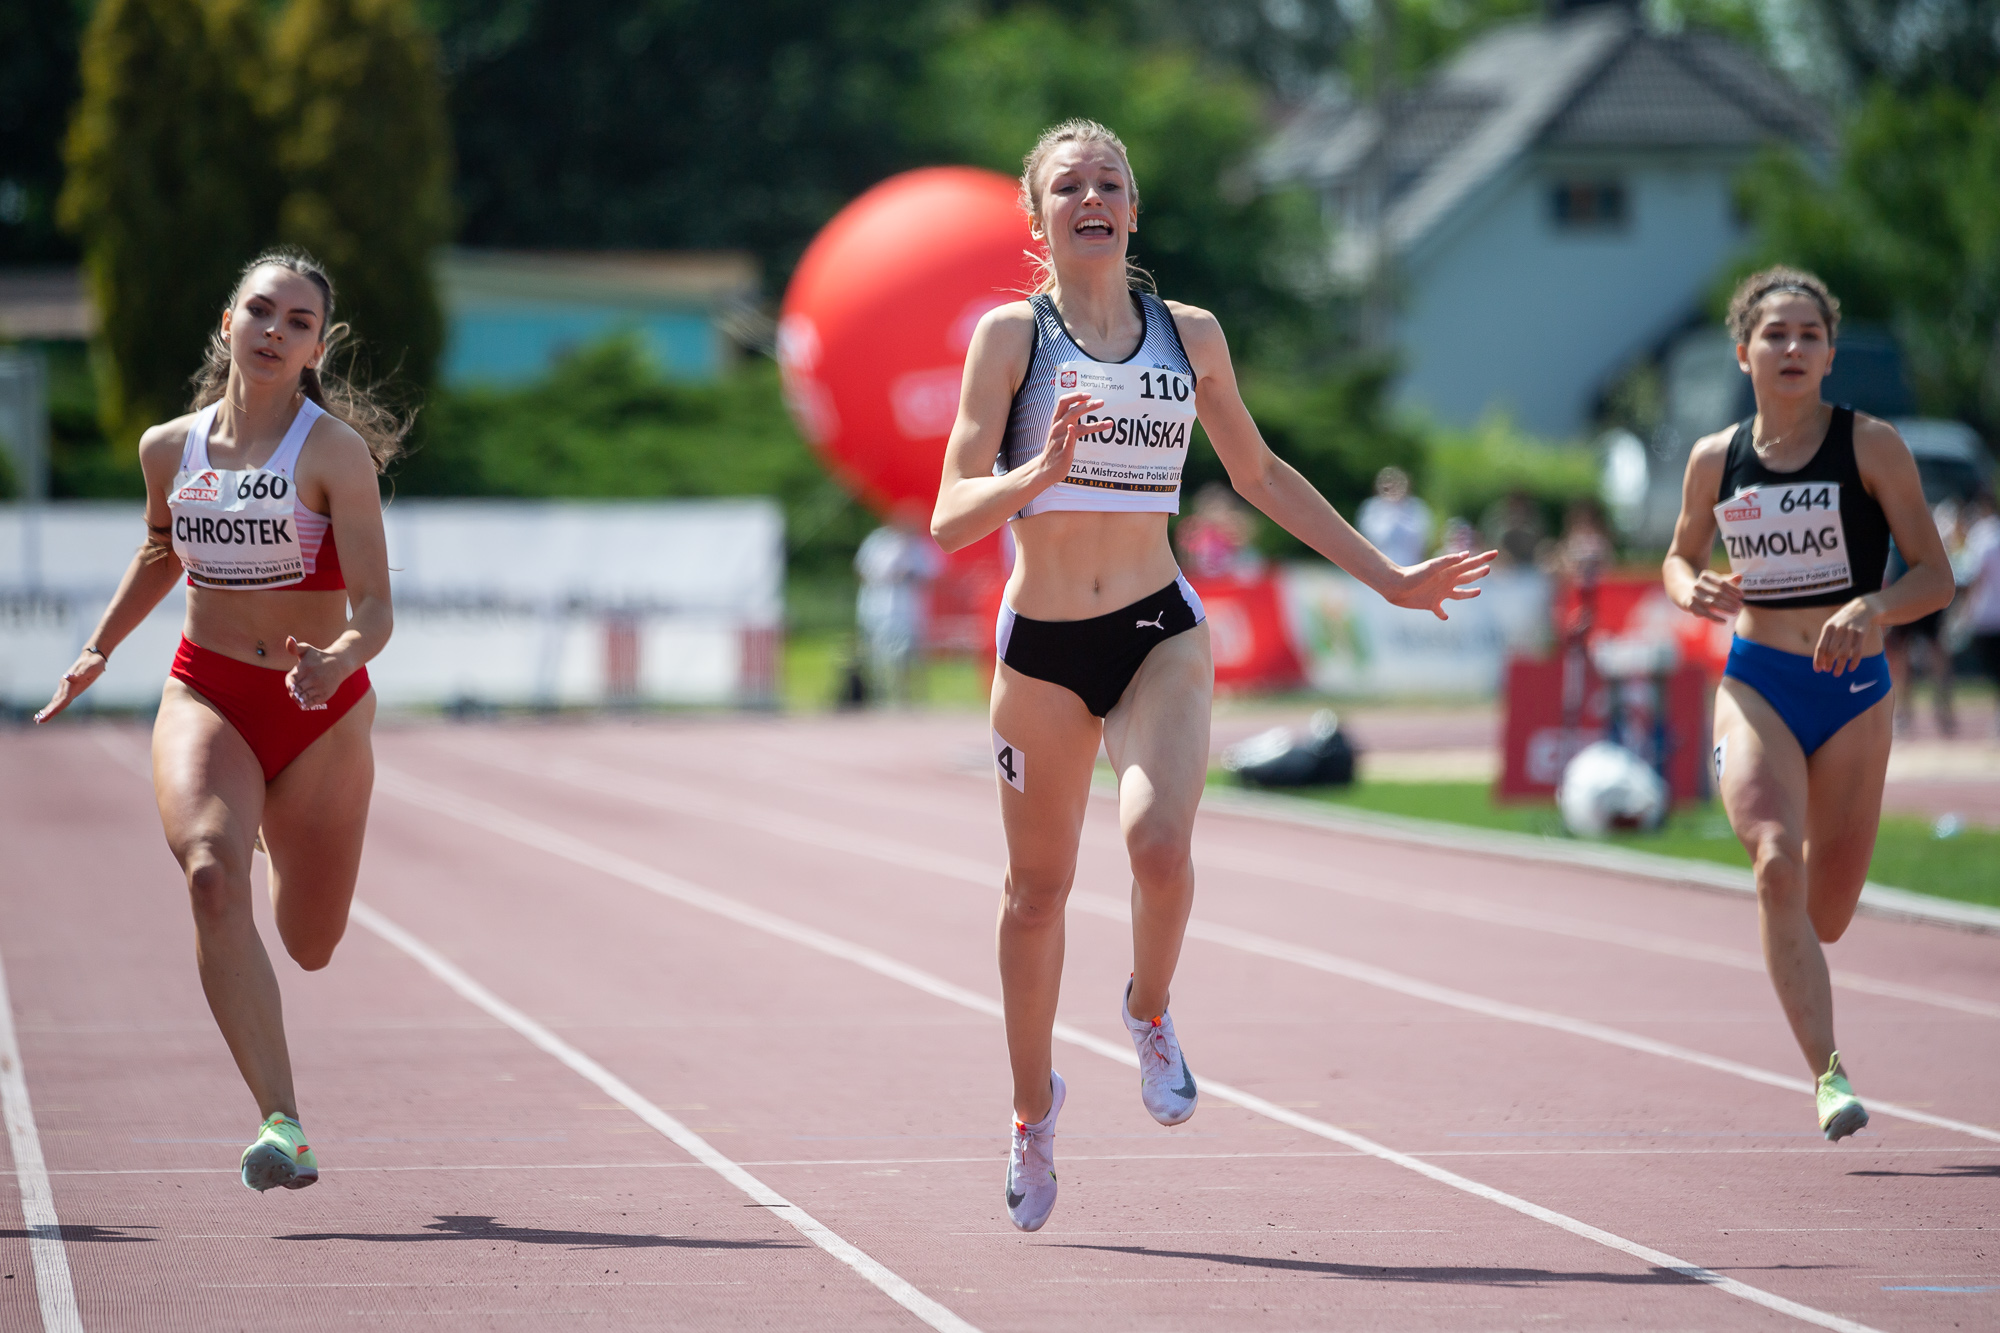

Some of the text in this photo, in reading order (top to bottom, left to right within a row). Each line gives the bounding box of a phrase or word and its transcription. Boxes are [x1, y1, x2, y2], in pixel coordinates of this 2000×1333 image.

[1140, 371, 1189, 402] 110
[1077, 413, 1185, 449] ROSIŃSKA
[1070, 464, 1088, 474] ZLA
[1090, 466, 1145, 480] Mistrzostwa
[1146, 471, 1169, 480] Polski
[180, 489, 216, 500] ORLEN
[237, 473, 288, 500] 660
[1780, 487, 1831, 514] 644
[1725, 508, 1759, 521] ORLEN
[176, 515, 292, 545] CHROSTEK
[1726, 526, 1838, 559] ZIMOLĄG
[205, 565, 253, 575] Mistrzostwa
[254, 564, 282, 575] Polski
[283, 560, 301, 571] U18
[997, 745, 1017, 782] 4
